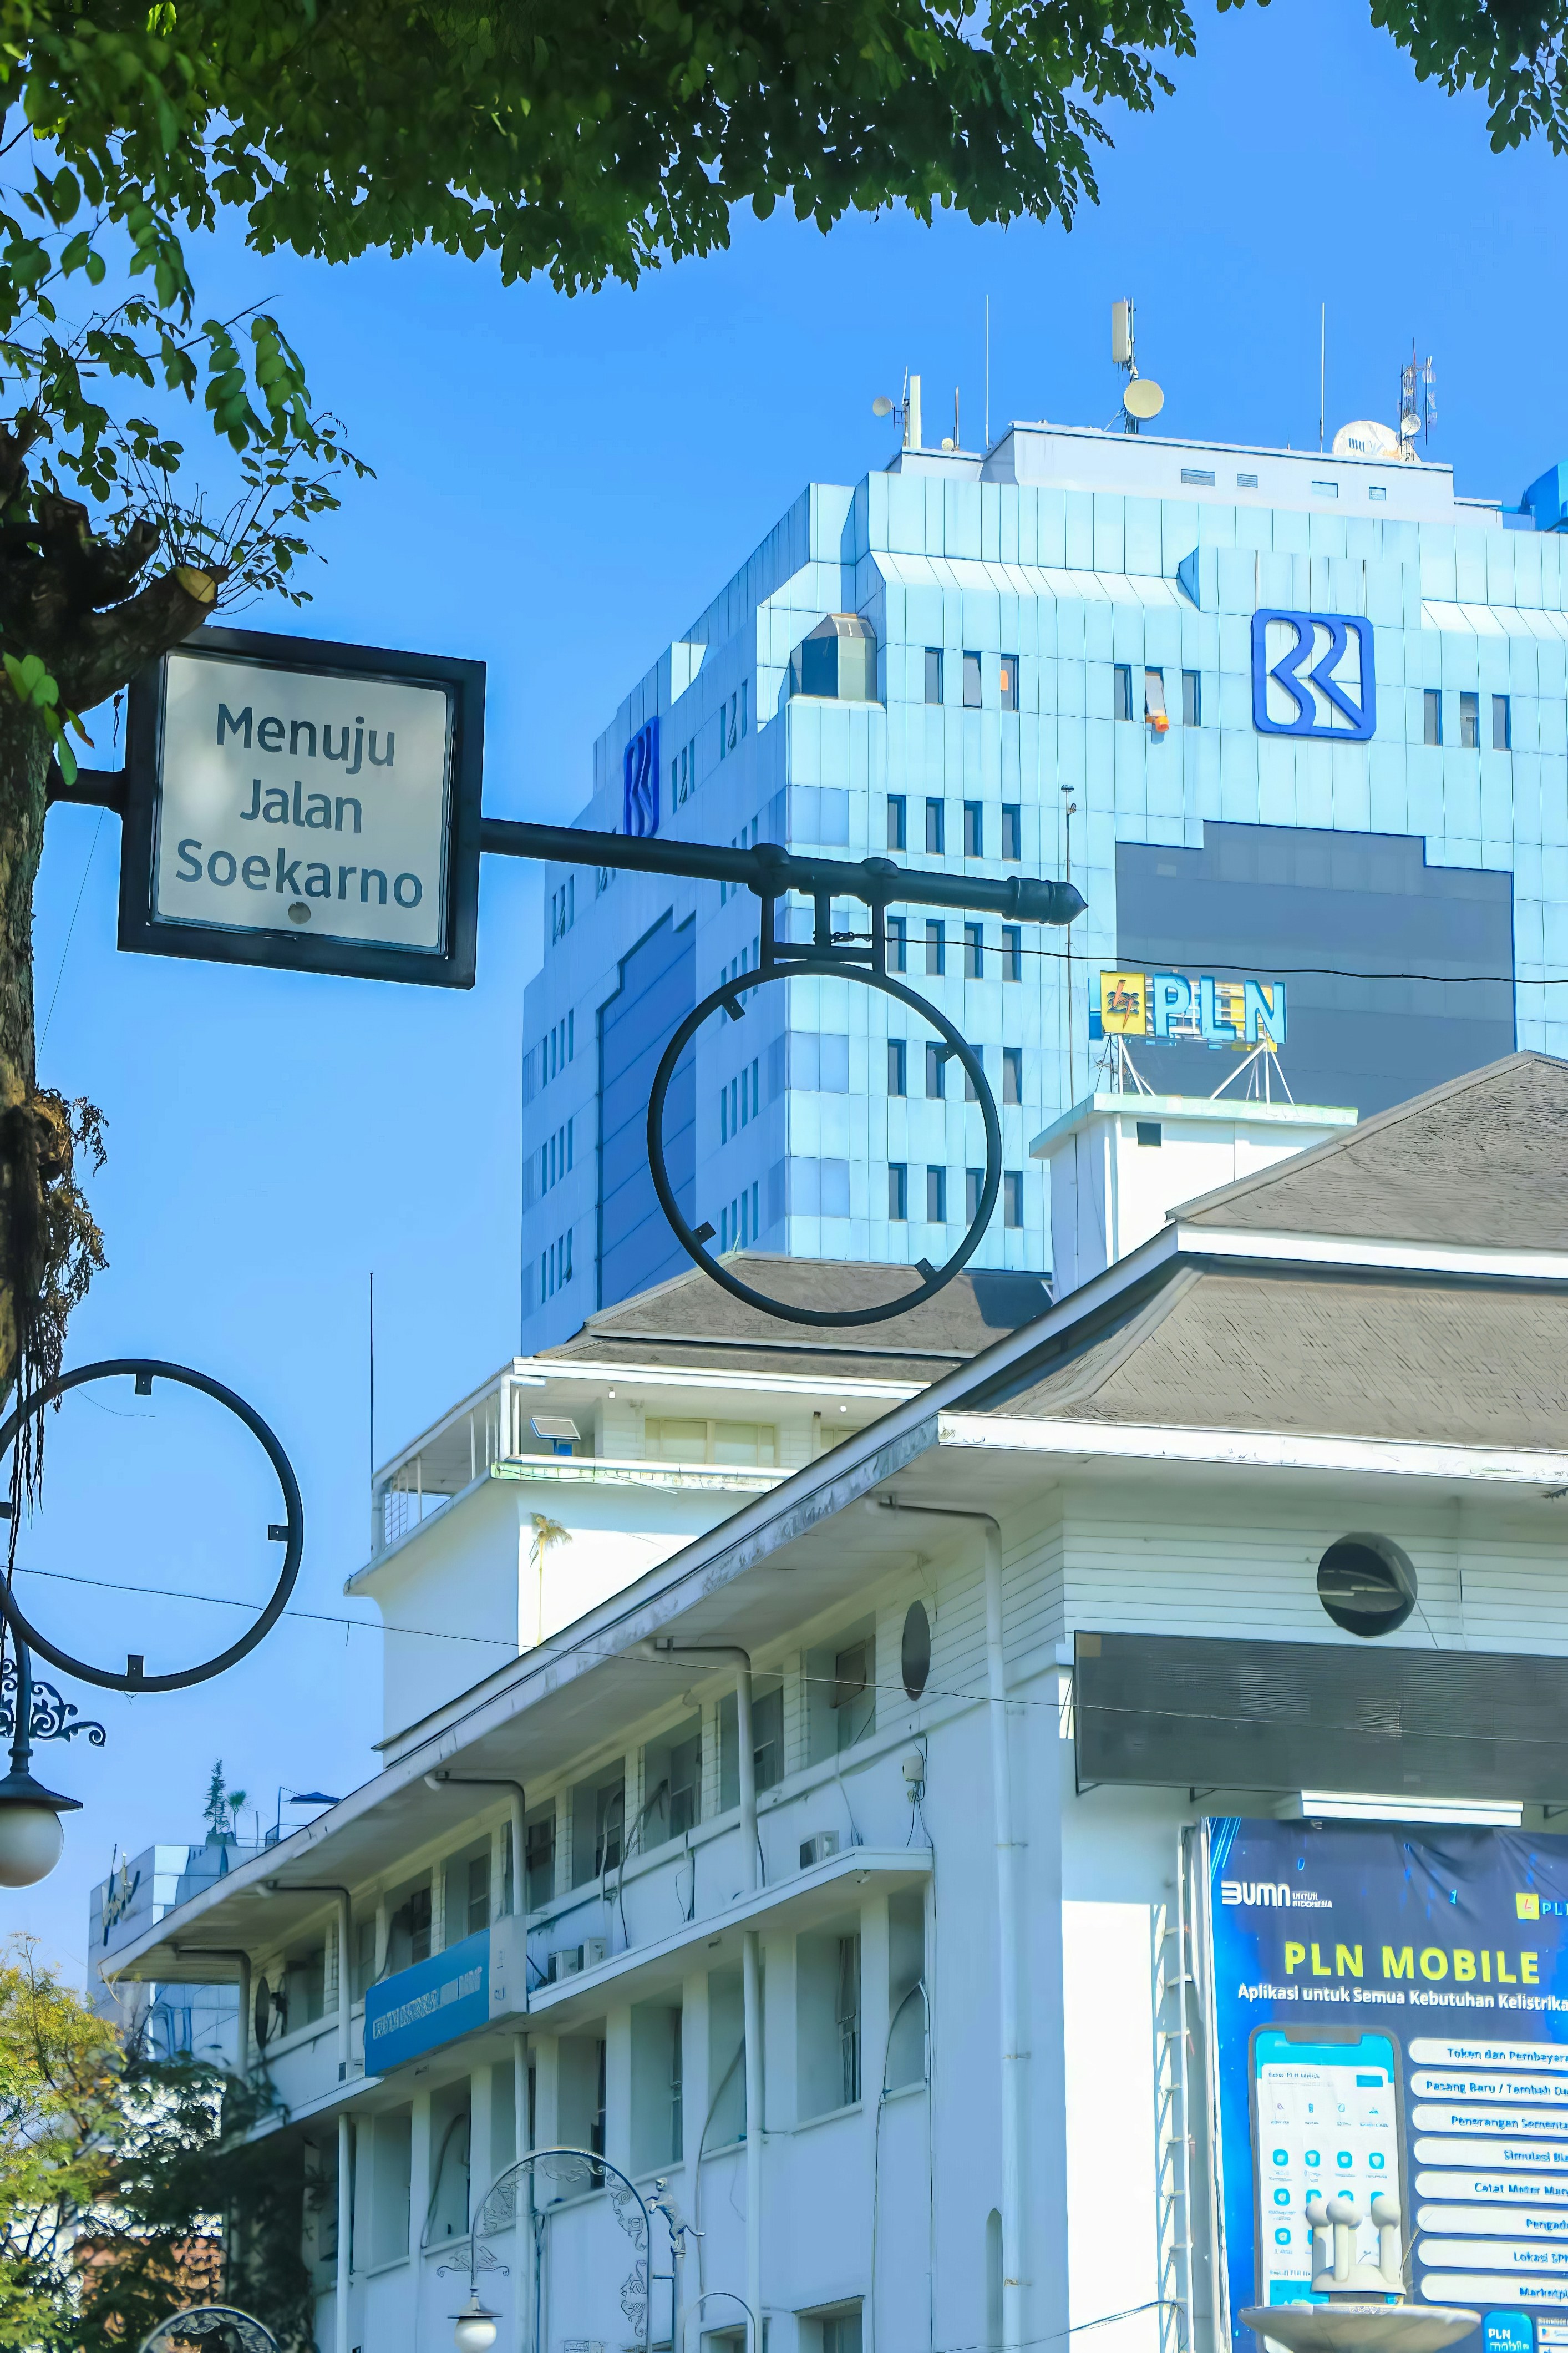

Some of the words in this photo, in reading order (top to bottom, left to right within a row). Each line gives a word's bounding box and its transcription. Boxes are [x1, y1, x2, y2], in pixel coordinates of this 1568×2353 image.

[216, 702, 395, 775] Menuju
[240, 778, 363, 833] Jalan
[175, 839, 423, 909] Soekarno
[1153, 971, 1287, 1044] PLN
[1221, 1880, 1291, 1907] BUMN
[1285, 1941, 1364, 1978] PLN
[1382, 1945, 1540, 1985] MOBILE
[1237, 1983, 1299, 2002] Aplikasi
[1302, 1986, 1351, 2002] untuk
[1353, 1987, 1405, 2005] Semua
[1409, 1990, 1495, 2008] Kebutuhan
[1447, 2048, 1481, 2059] Token
[1484, 2050, 1506, 2060] dan
[1451, 2116, 1519, 2130] Penerangan
[1514, 2251, 1548, 2264] Lokasi
[1488, 2328, 1511, 2340] PLN
